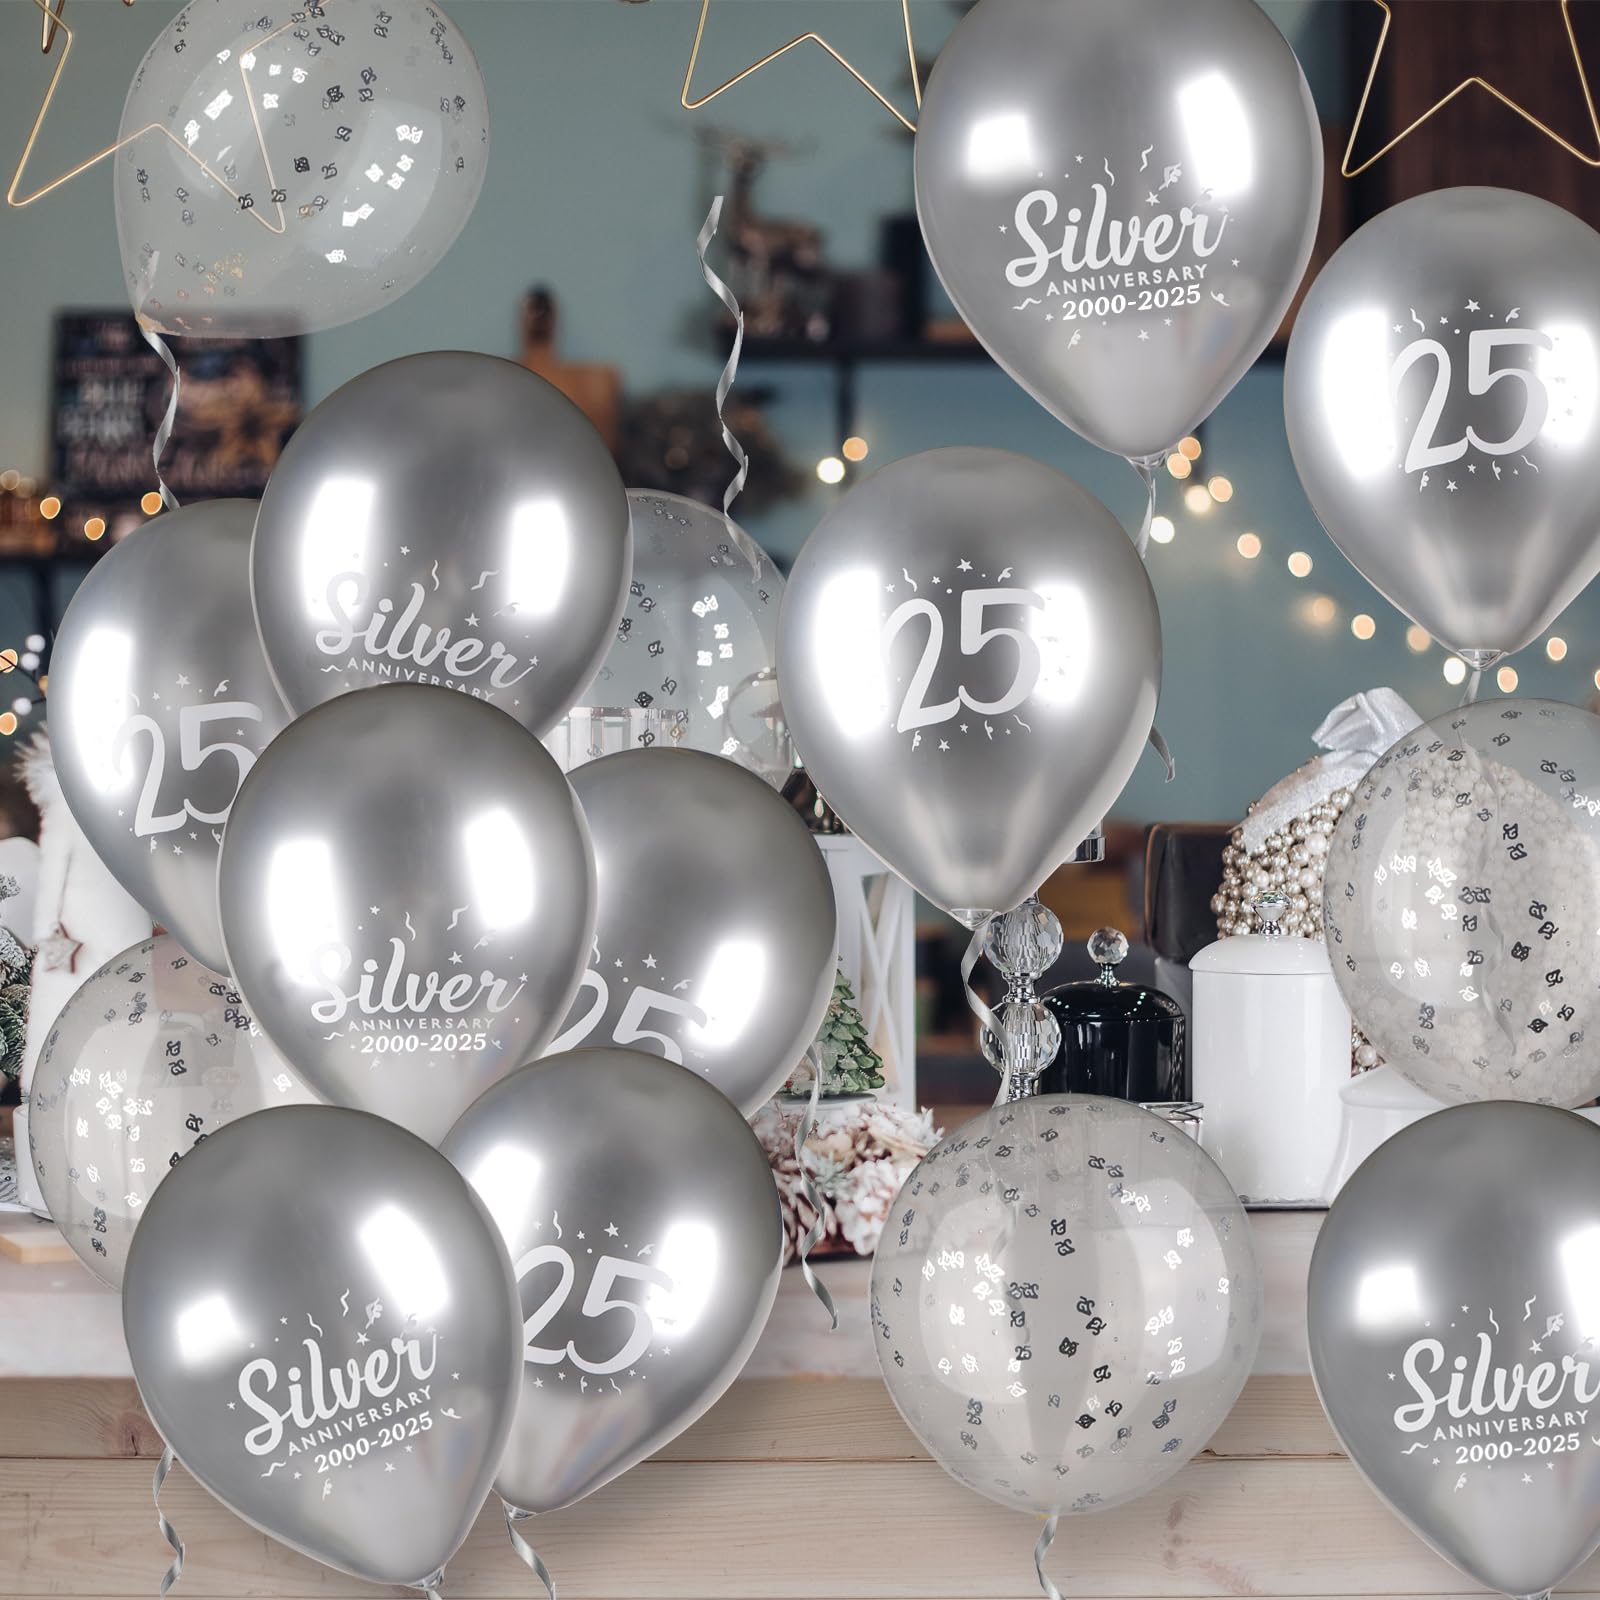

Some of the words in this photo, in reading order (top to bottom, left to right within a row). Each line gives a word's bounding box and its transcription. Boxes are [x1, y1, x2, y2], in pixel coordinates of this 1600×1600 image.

[1005, 183, 1228, 287] Silver
[1046, 263, 1208, 297] ANNIVERSARY
[1062, 284, 1201, 320] 2000-2025
[1389, 328, 1553, 474] 25
[315, 571, 534, 688] Silver
[880, 588, 1045, 733] 25
[112, 701, 263, 837] 25
[311, 937, 526, 1023] Silver
[348, 1018, 496, 1032] ANNIVERSARY
[360, 1033, 487, 1052] 2000-2025
[514, 1245, 674, 1374] 25
[238, 1333, 437, 1456] Silver
[288, 1385, 432, 1456] ANNIVERSARY
[1394, 1332, 1600, 1433] Silver
[1434, 1410, 1588, 1441] ANNIVERSARY
[314, 1411, 433, 1473] 2000-2025
[1456, 1432, 1580, 1464] 2000-2025
